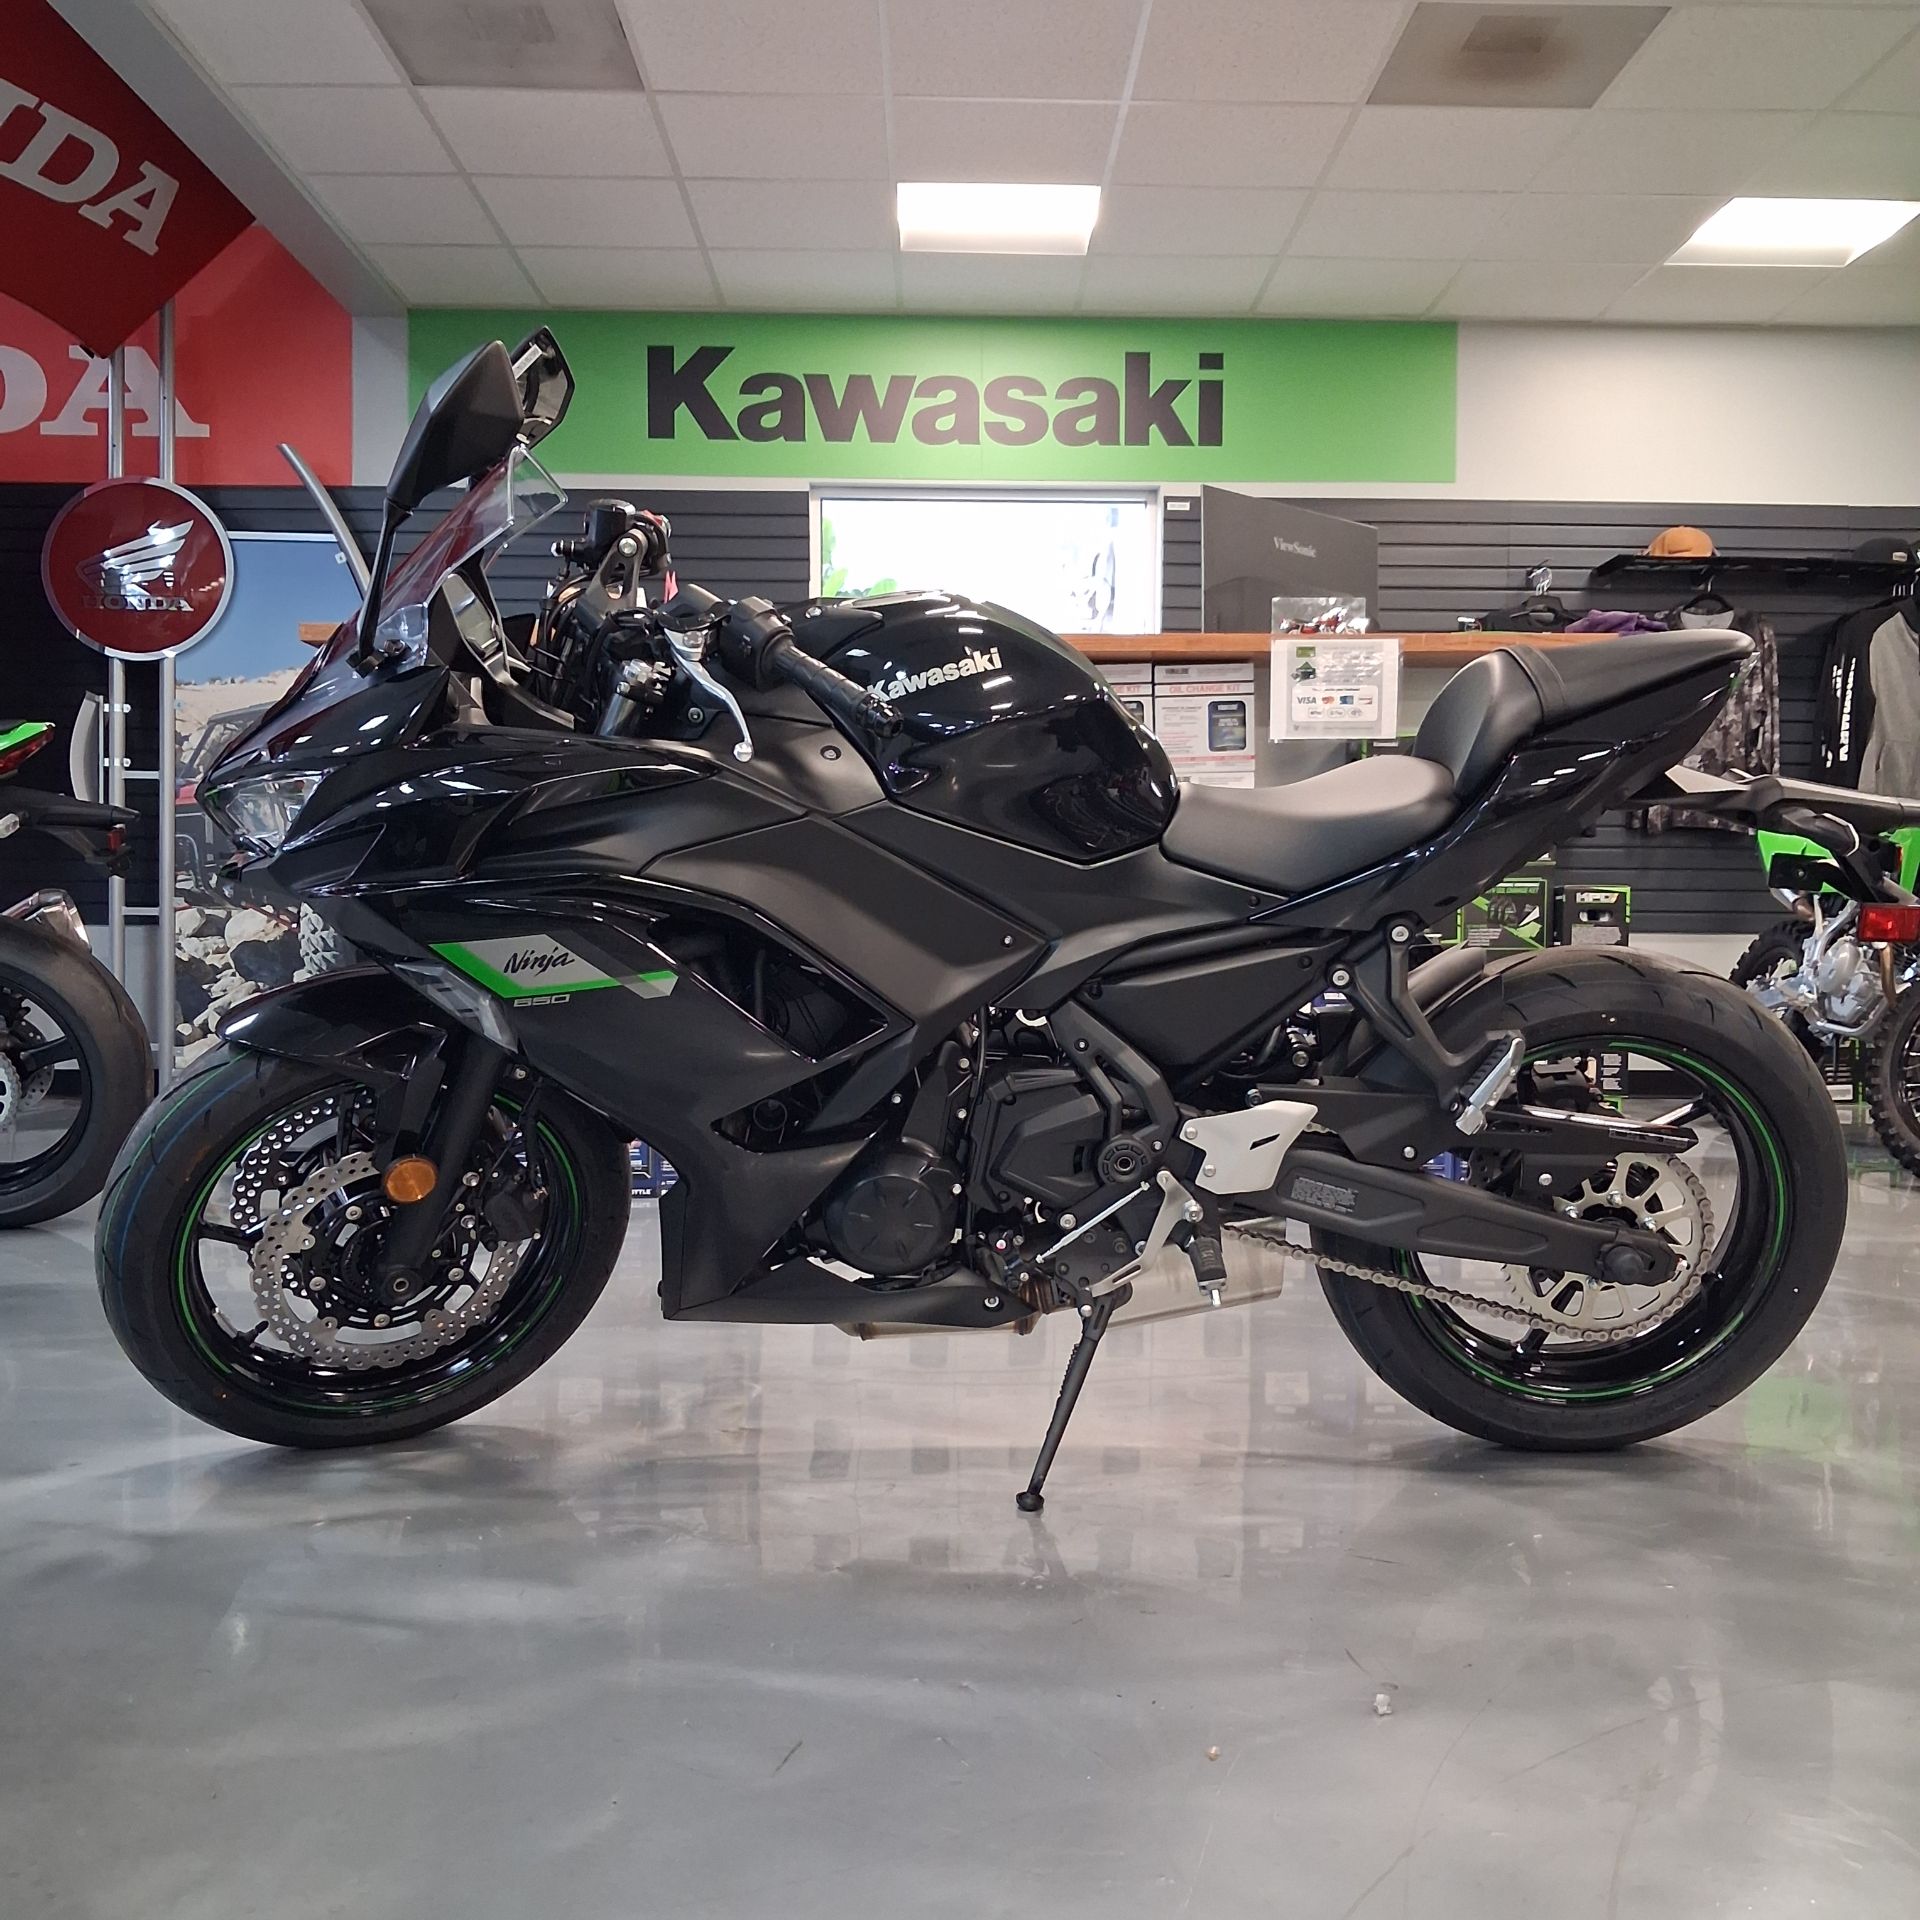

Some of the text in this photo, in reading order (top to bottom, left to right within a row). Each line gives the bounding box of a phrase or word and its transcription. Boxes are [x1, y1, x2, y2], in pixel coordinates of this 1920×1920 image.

[647, 345, 1224, 447] Kawasaki
[82, 595, 195, 612] HONDA
[866, 647, 1003, 702] Kawasaki
[1186, 685, 1225, 693] CHANGE
[1226, 684, 1241, 692] KIT
[1297, 696, 1317, 705] VISA
[503, 946, 576, 977] Ninja
[513, 994, 571, 1008] 650
